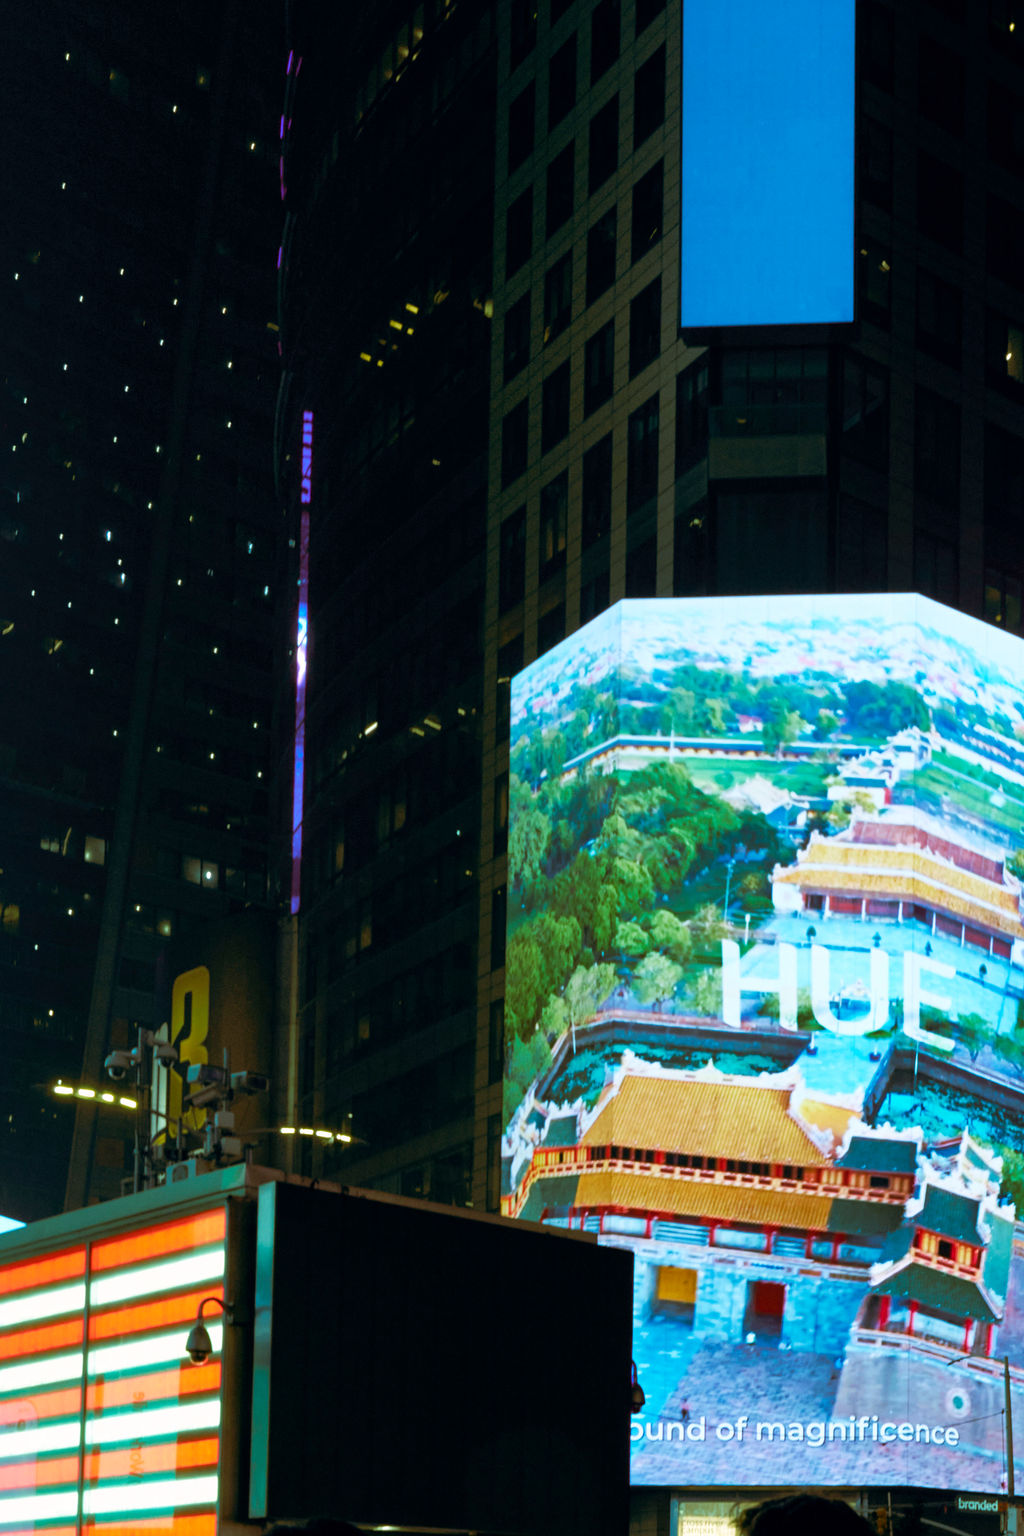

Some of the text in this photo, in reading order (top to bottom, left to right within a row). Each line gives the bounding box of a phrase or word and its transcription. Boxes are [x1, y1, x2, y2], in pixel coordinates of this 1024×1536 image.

[722, 938, 956, 1051] HUE
[715, 1416, 750, 1441] of
[756, 1416, 960, 1447] magnificence
[958, 1497, 998, 1512] branded
